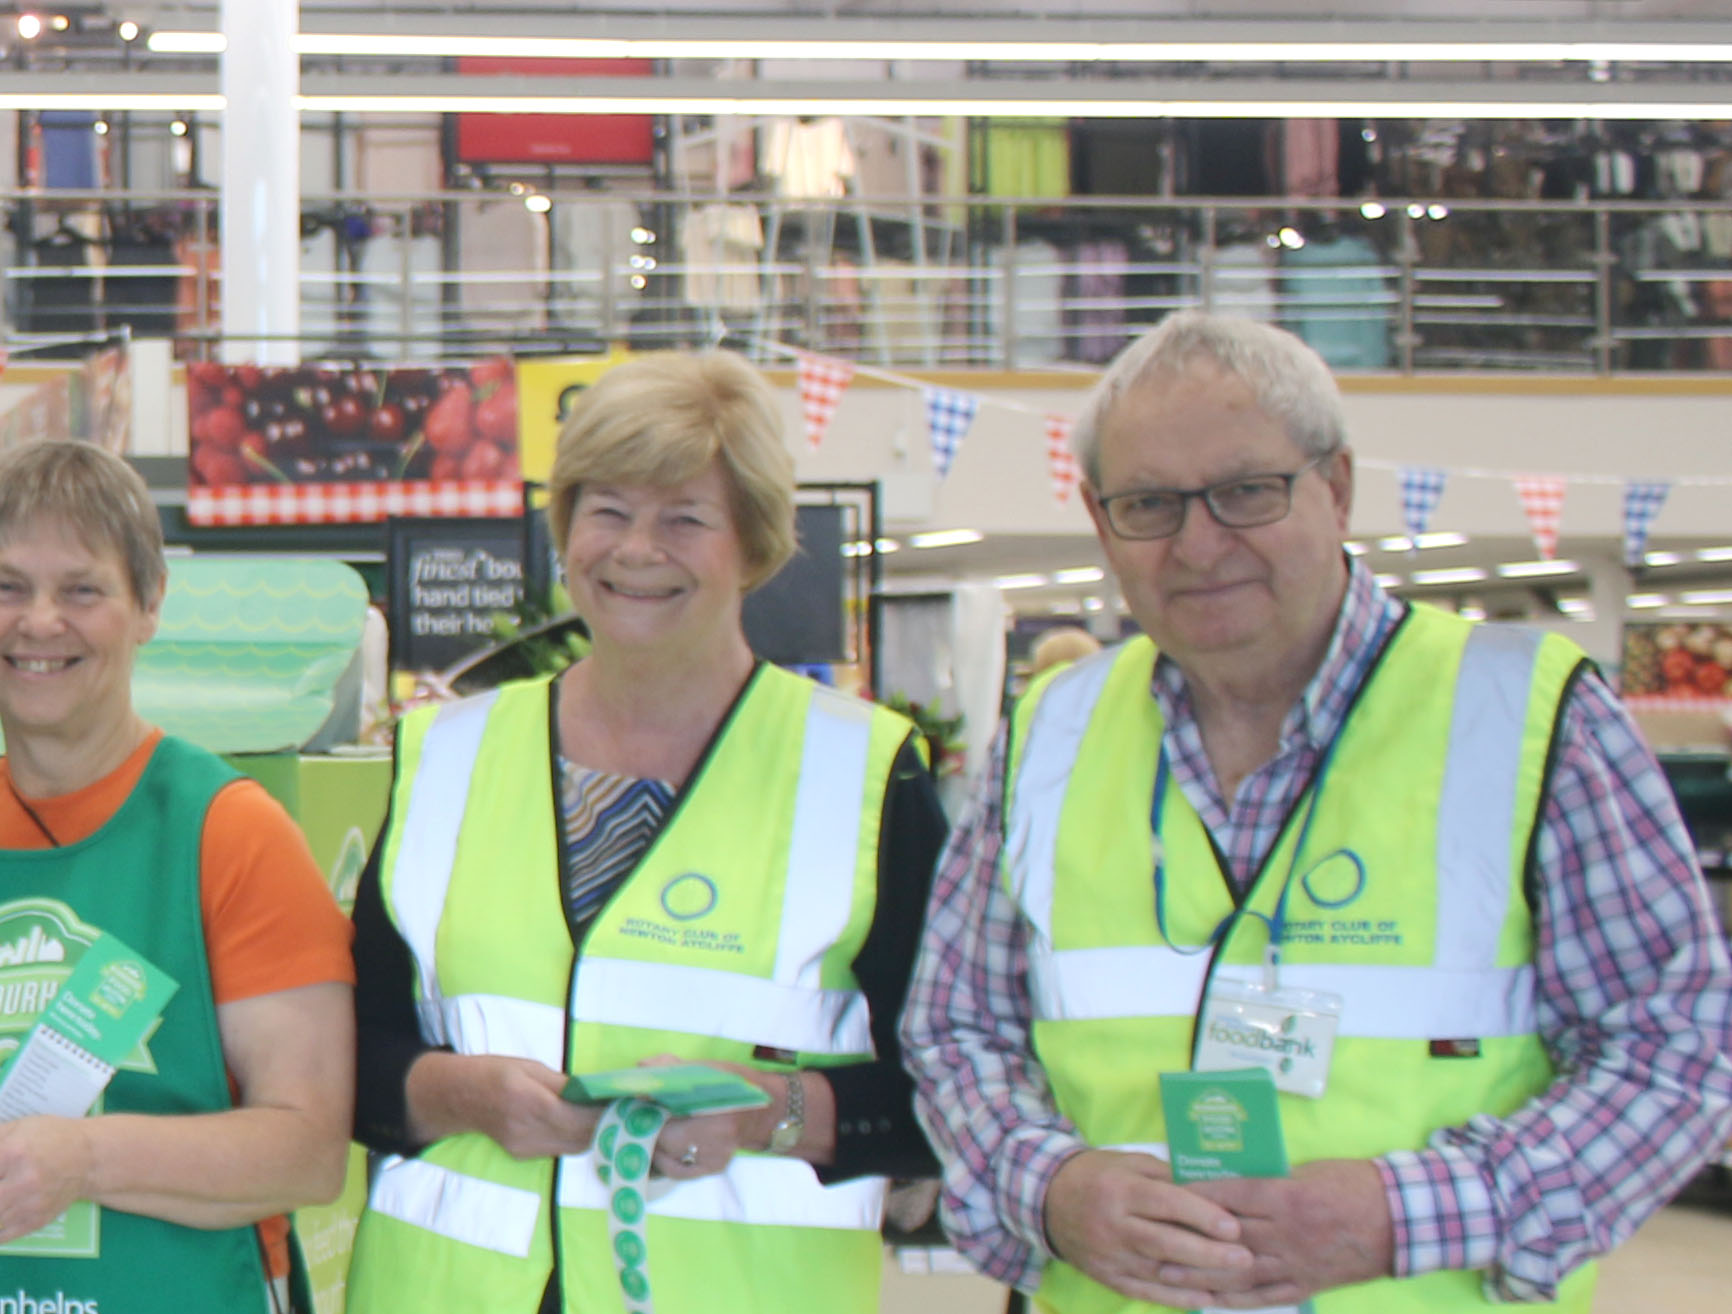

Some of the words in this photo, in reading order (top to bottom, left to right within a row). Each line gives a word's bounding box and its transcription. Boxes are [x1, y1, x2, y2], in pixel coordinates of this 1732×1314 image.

[412, 584, 470, 607] hand
[475, 584, 515, 607] tied
[412, 612, 464, 635] their
[1208, 1023, 1316, 1059] foodbank
